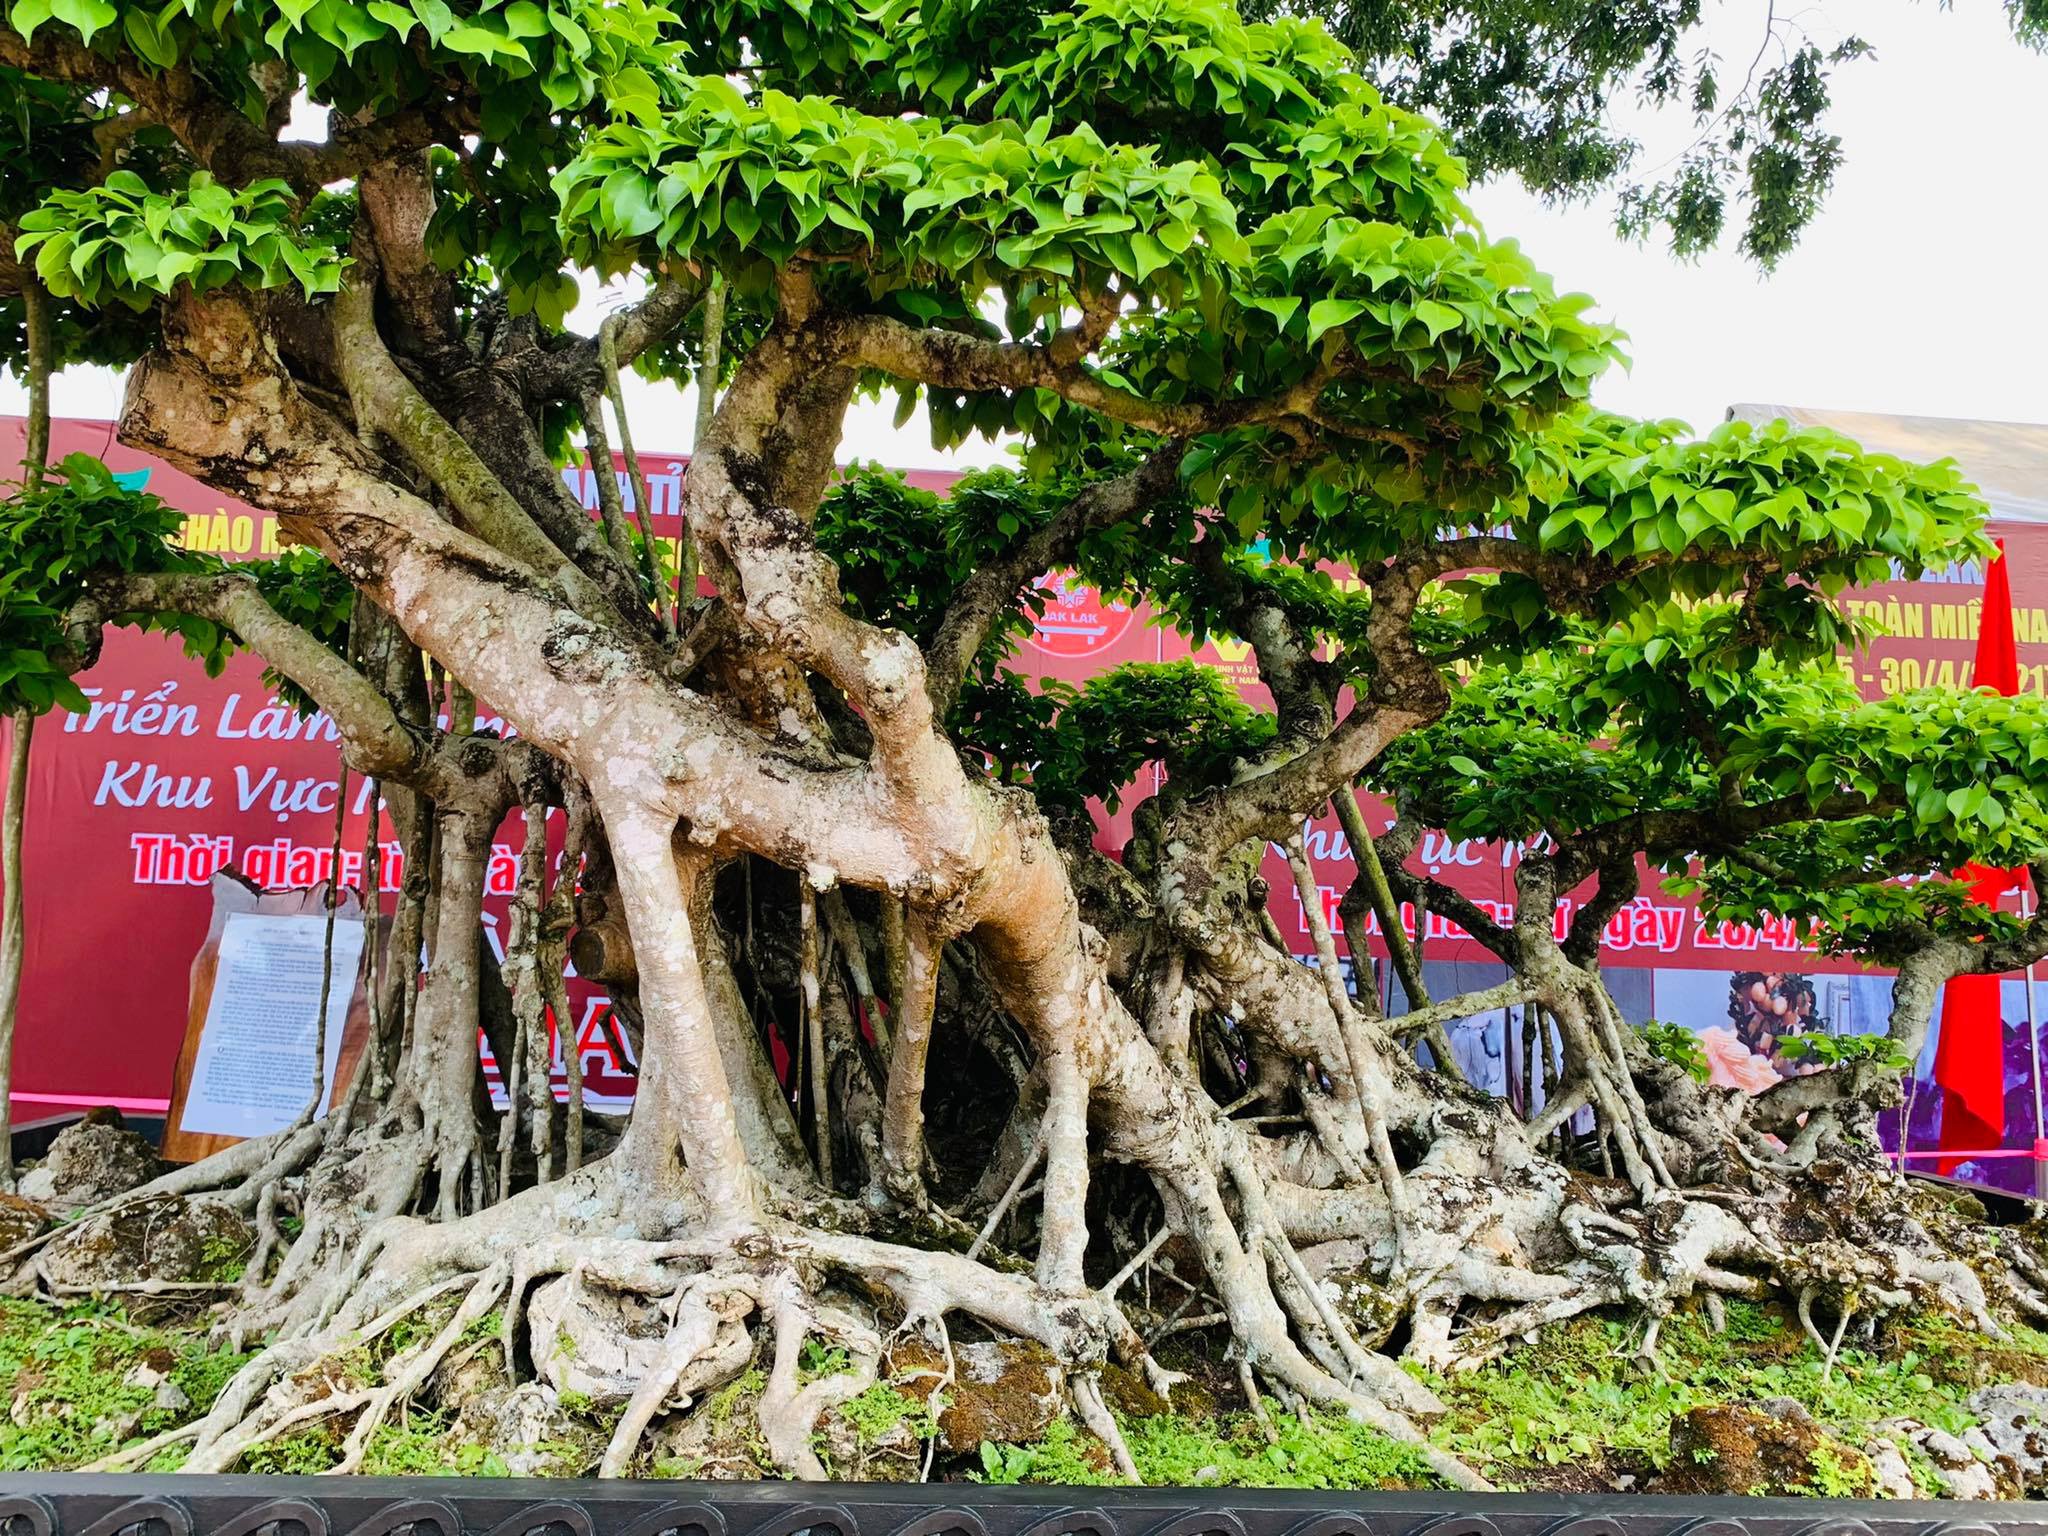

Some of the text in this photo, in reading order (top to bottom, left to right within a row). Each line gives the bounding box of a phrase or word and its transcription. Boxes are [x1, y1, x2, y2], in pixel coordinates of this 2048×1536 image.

[1931, 598, 1982, 640] MIỀ
[94, 760, 213, 809] Khu
[234, 765, 339, 822] Vực
[131, 833, 234, 886] Thời
[1596, 897, 1688, 952] gày
